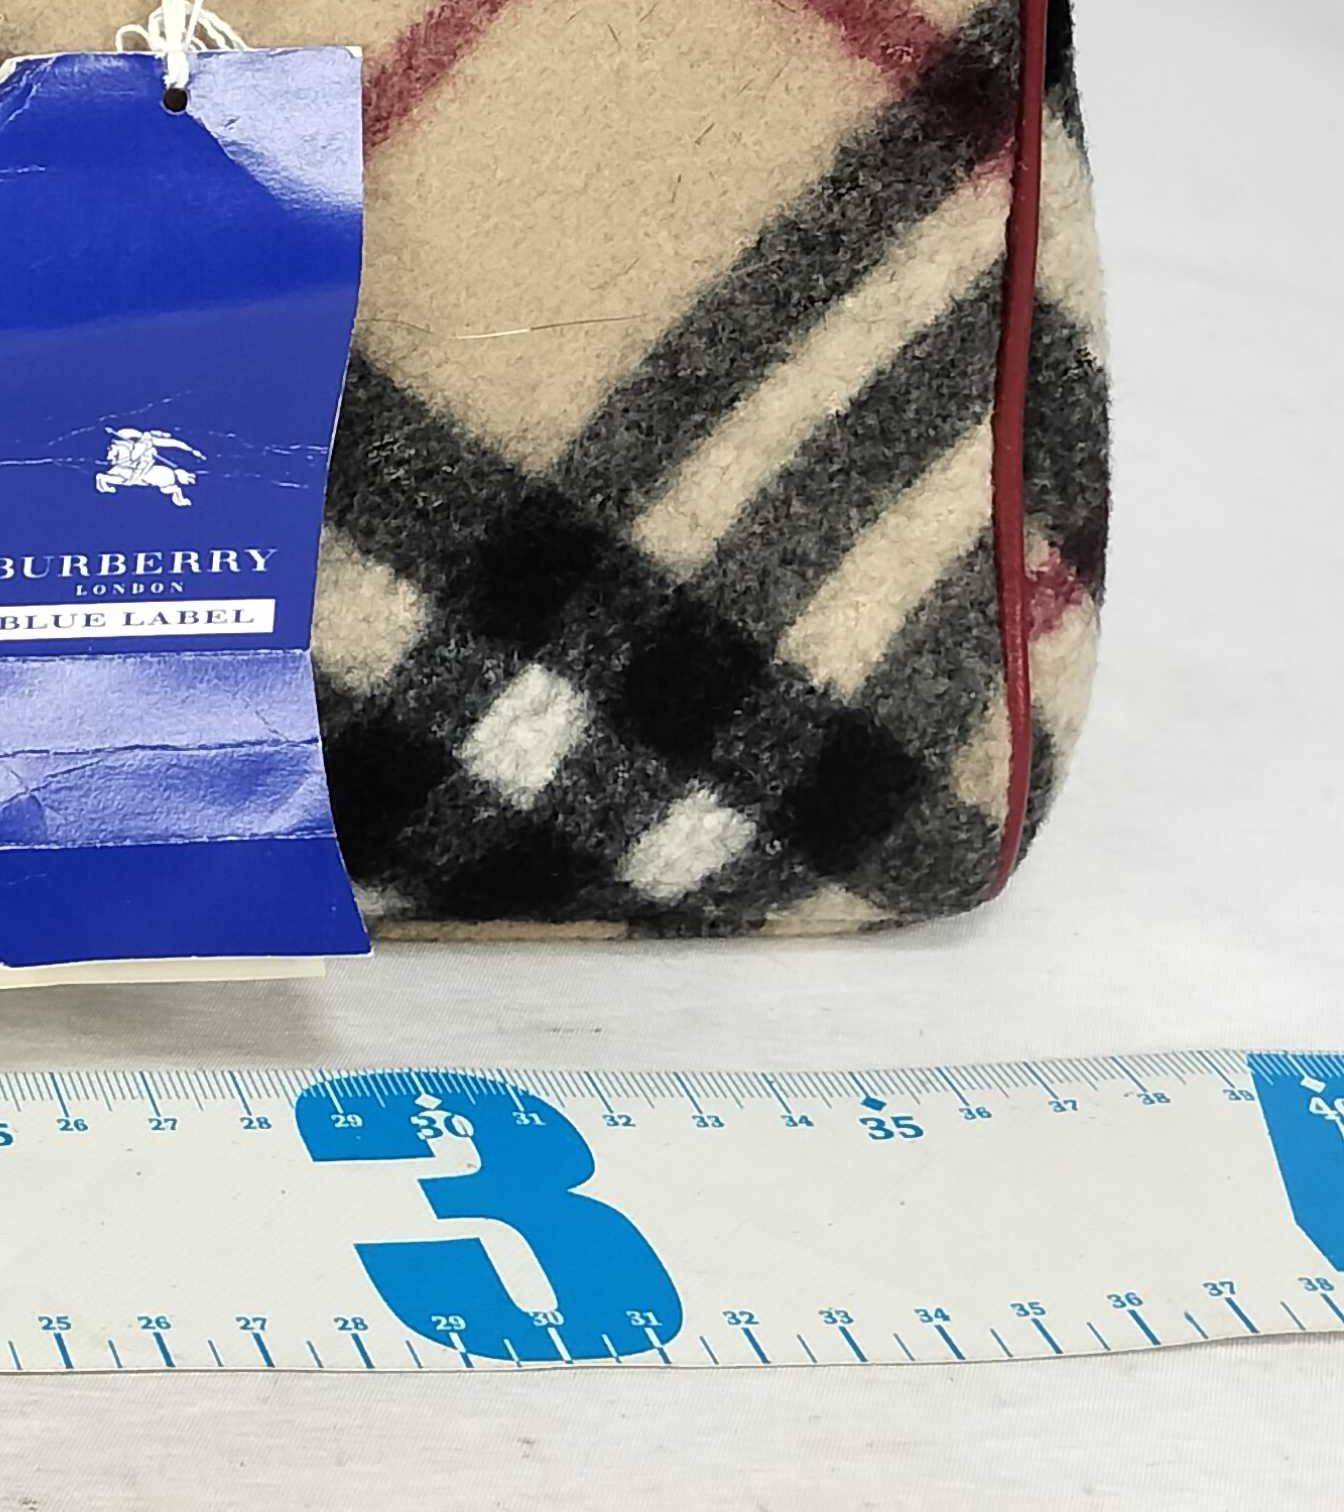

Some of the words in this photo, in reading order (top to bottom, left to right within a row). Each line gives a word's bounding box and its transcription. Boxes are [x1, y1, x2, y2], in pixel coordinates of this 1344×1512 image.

[75, 581, 185, 596] LONDON
[122, 608, 255, 628] LABEL
[57, 1118, 89, 1132] 26
[149, 1118, 179, 1132] 27
[240, 1117, 272, 1130] 28
[331, 1114, 363, 1128] 29
[410, 1110, 474, 1139] 30
[515, 1113, 547, 1127] 31
[603, 1114, 635, 1128] 32
[692, 1115, 724, 1128] 33
[780, 1115, 814, 1128] 34
[859, 1116, 924, 1140] 35
[959, 1106, 992, 1120] 36
[1048, 1099, 1079, 1113] 37
[1137, 1092, 1171, 1105] 38
[1222, 1088, 1255, 1101] 39
[295, 1071, 683, 1361] 3
[38, 1316, 72, 1331] 25
[137, 1316, 172, 1331] 26
[235, 1317, 268, 1331] 27
[334, 1317, 368, 1332] 28
[432, 1316, 466, 1331] 29
[531, 1311, 565, 1326] 30
[626, 1311, 662, 1326] 31
[722, 1311, 759, 1326] 32
[819, 1309, 854, 1325] 33
[914, 1308, 951, 1323] 34
[1010, 1302, 1046, 1318] 35
[1106, 1292, 1144, 1309] 36
[1203, 1281, 1237, 1297] 37
[1298, 1277, 1335, 1292] 38
